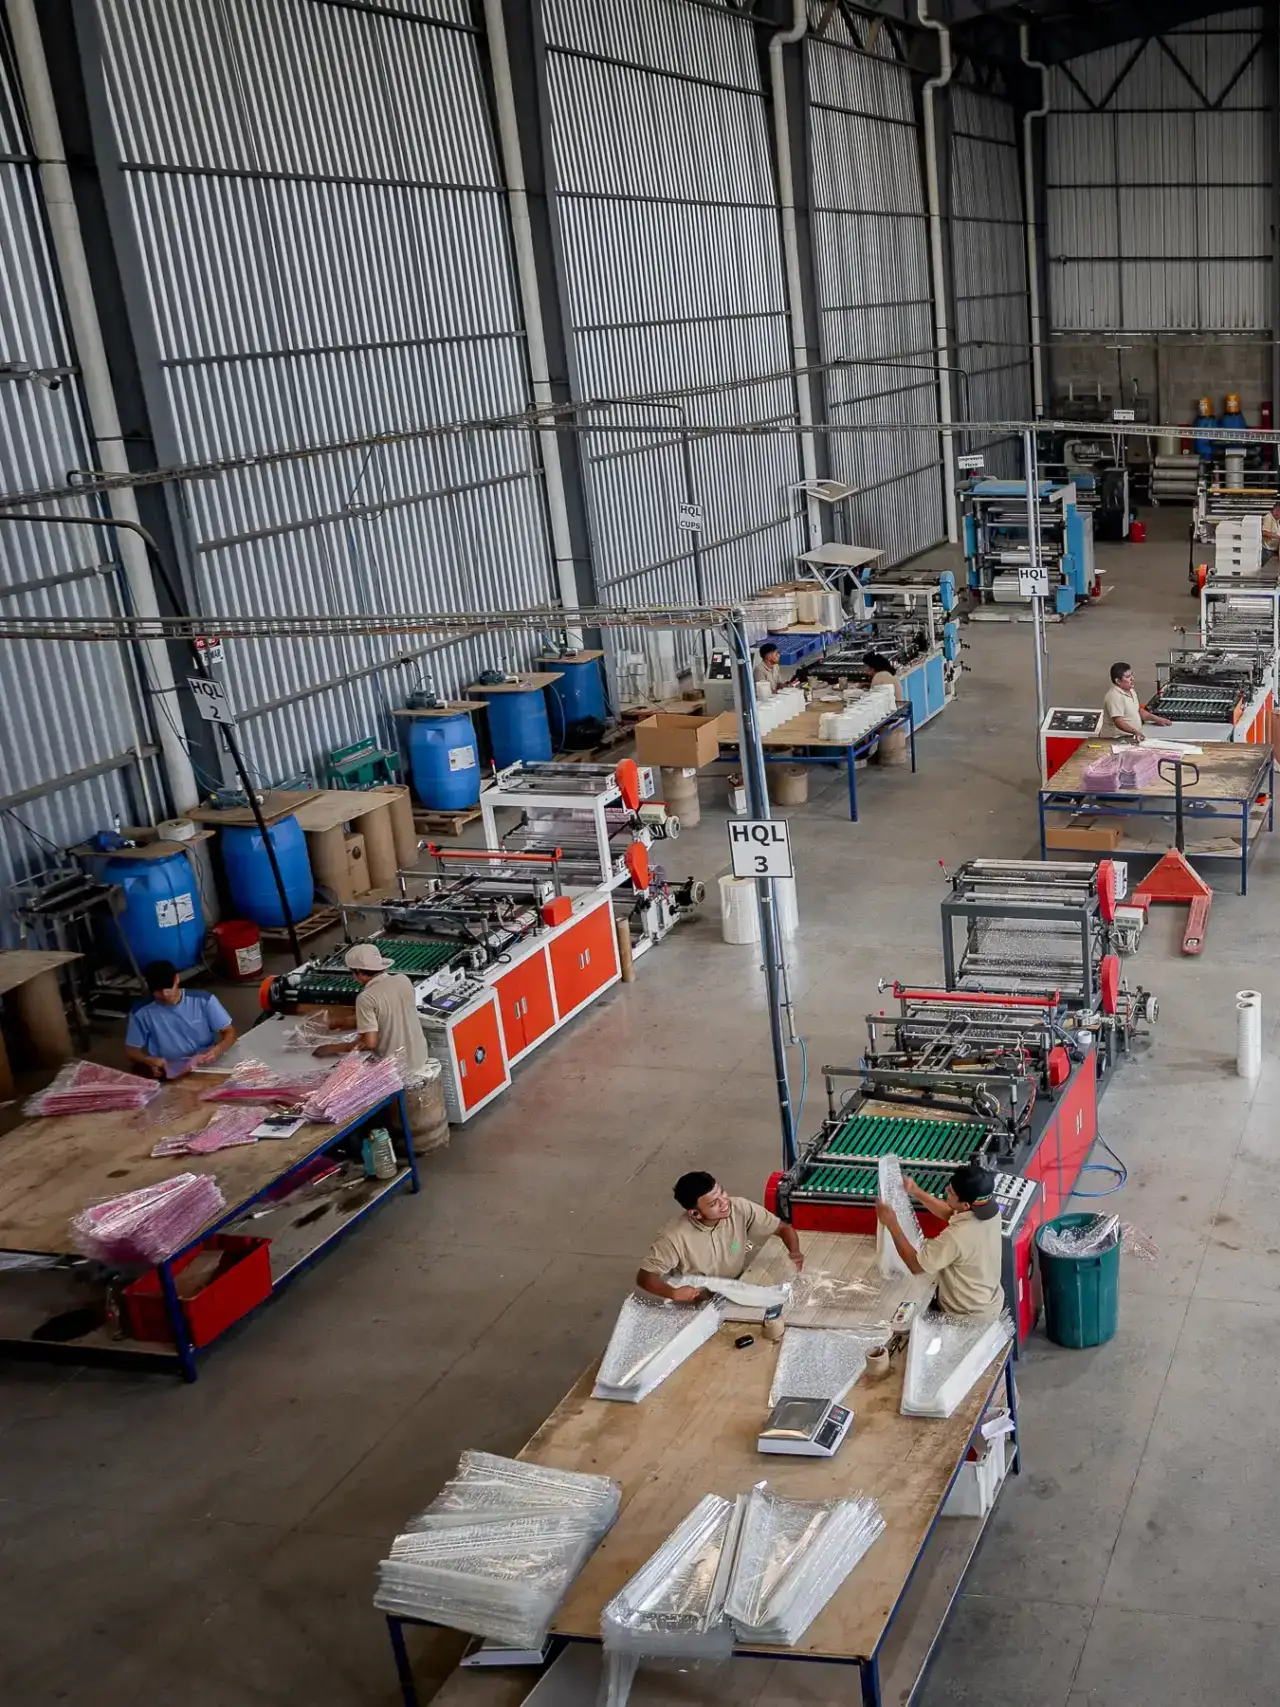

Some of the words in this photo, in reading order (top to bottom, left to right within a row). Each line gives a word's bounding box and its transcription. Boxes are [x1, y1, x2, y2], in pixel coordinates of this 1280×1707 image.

[680, 505, 702, 517] HQL
[680, 520, 701, 529] CUPS
[1020, 569, 1047, 581] HQL
[1030, 585, 1038, 594] 1
[190, 681, 224, 700] HQL
[210, 705, 222, 719] 2
[732, 824, 785, 847] HQL
[754, 855, 769, 873] 3
